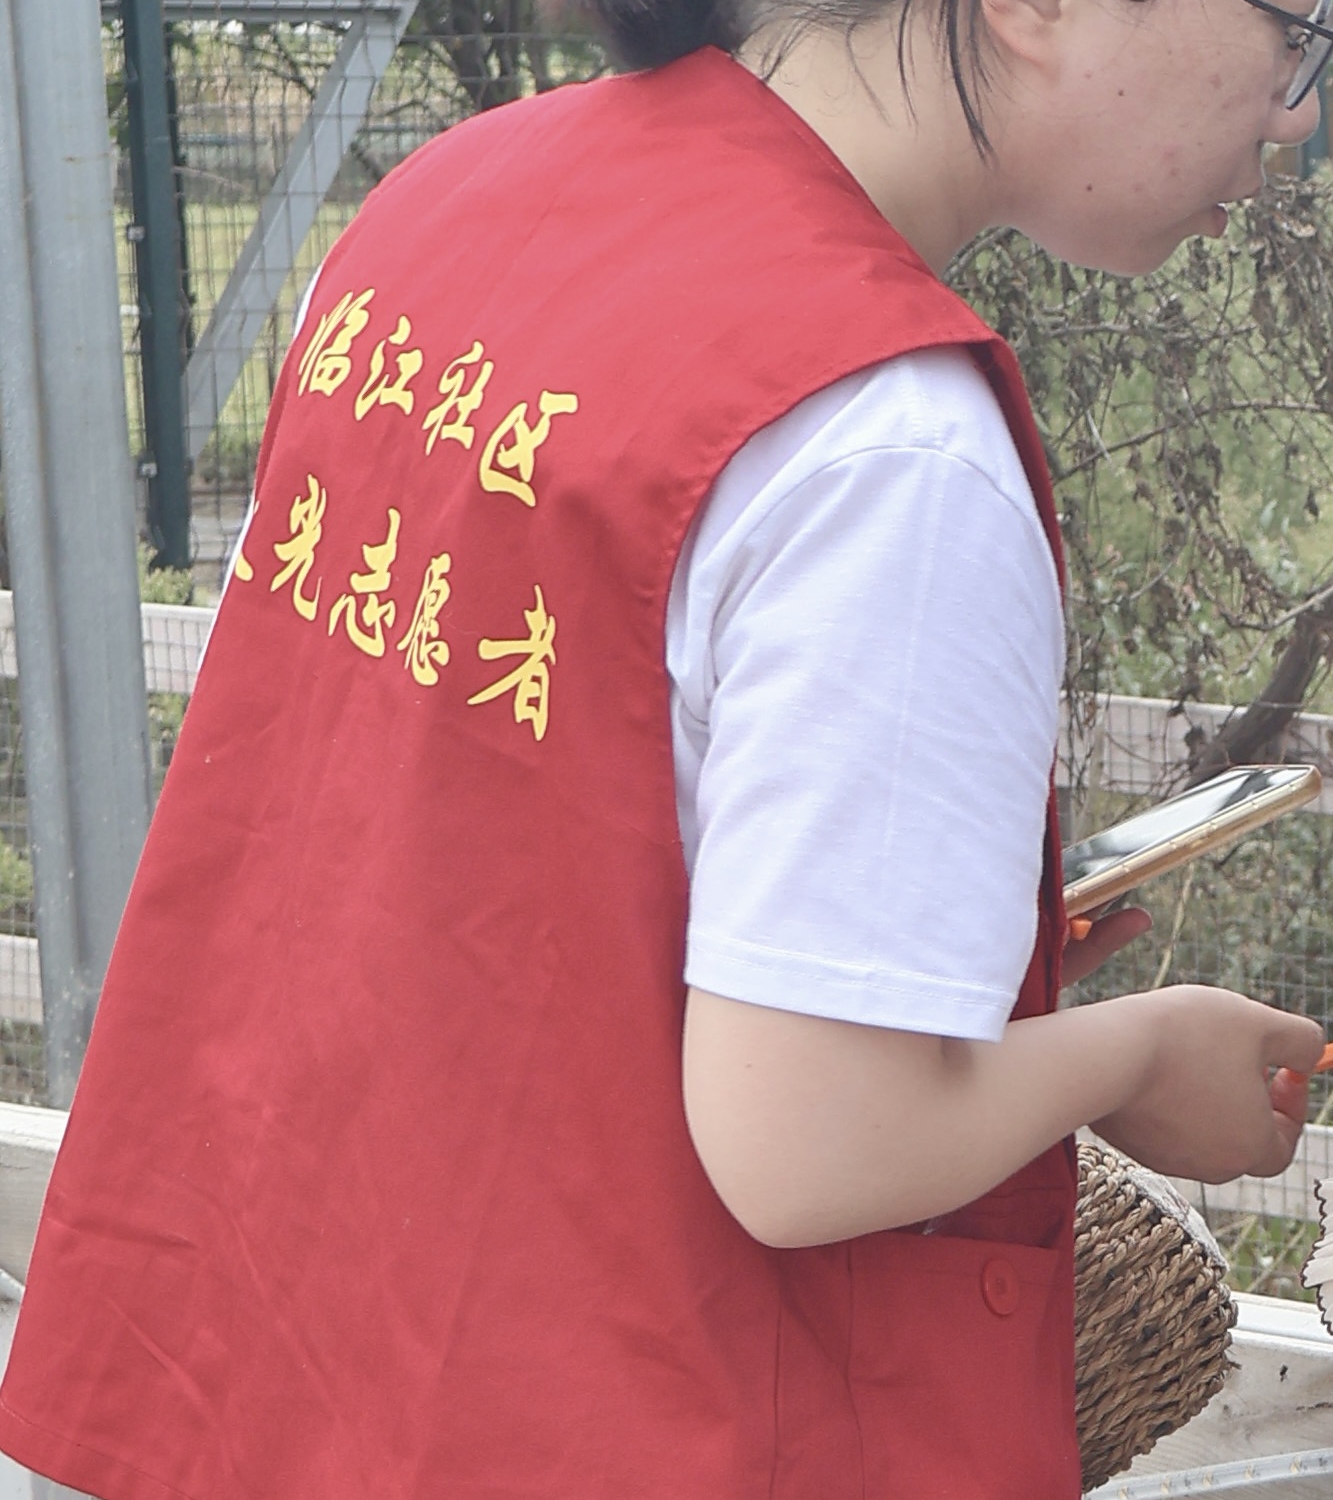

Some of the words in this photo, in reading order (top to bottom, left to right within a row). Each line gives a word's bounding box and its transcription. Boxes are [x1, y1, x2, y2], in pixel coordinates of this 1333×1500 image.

[297, 288, 578, 507] 临江社区
[233, 474, 557, 741] 光志愿者
